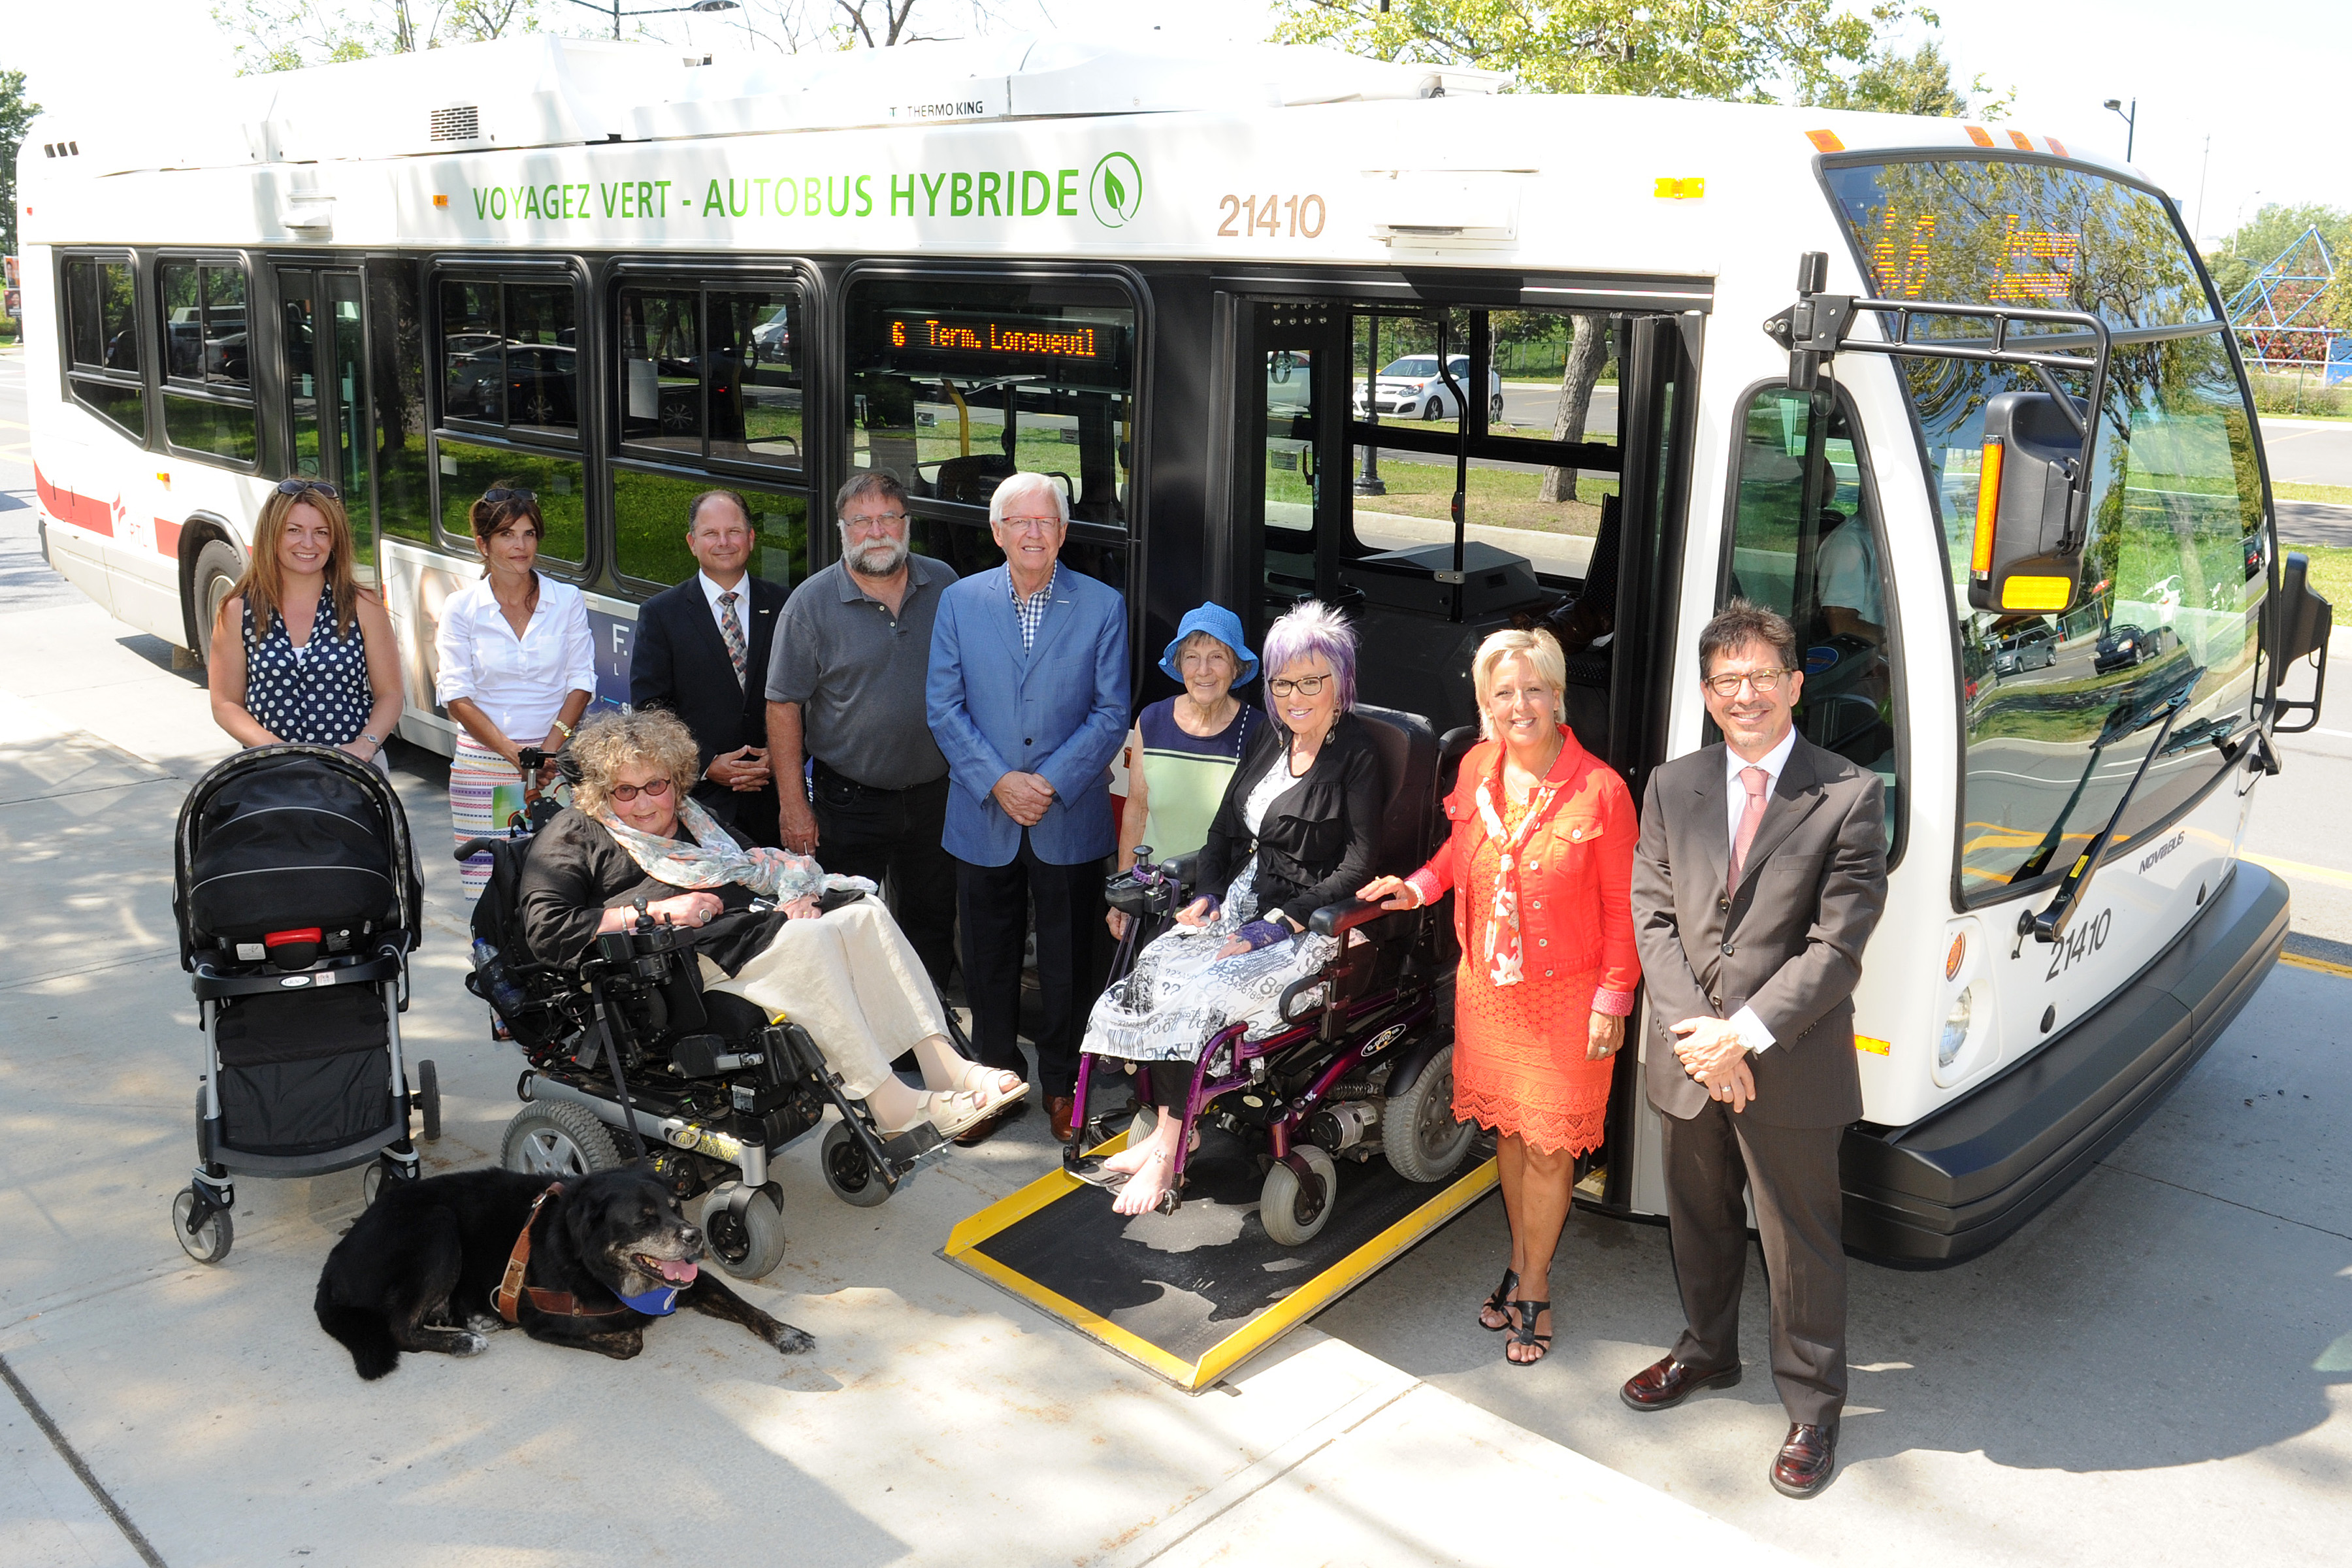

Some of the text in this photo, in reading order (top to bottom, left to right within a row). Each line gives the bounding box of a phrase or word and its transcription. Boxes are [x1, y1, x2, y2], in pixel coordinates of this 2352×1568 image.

[907, 103, 953, 117] THERMO
[956, 101, 983, 115] KING
[473, 184, 591, 220] VOYAGEZ
[601, 180, 672, 218] VERT
[703, 174, 873, 218] AUTOBUS
[890, 169, 1079, 217] HYBRIDE
[1217, 194, 1326, 238] 21410
[892, 321, 906, 347] 6
[926, 319, 982, 349] Term.
[2045, 907, 2112, 983] 21410
